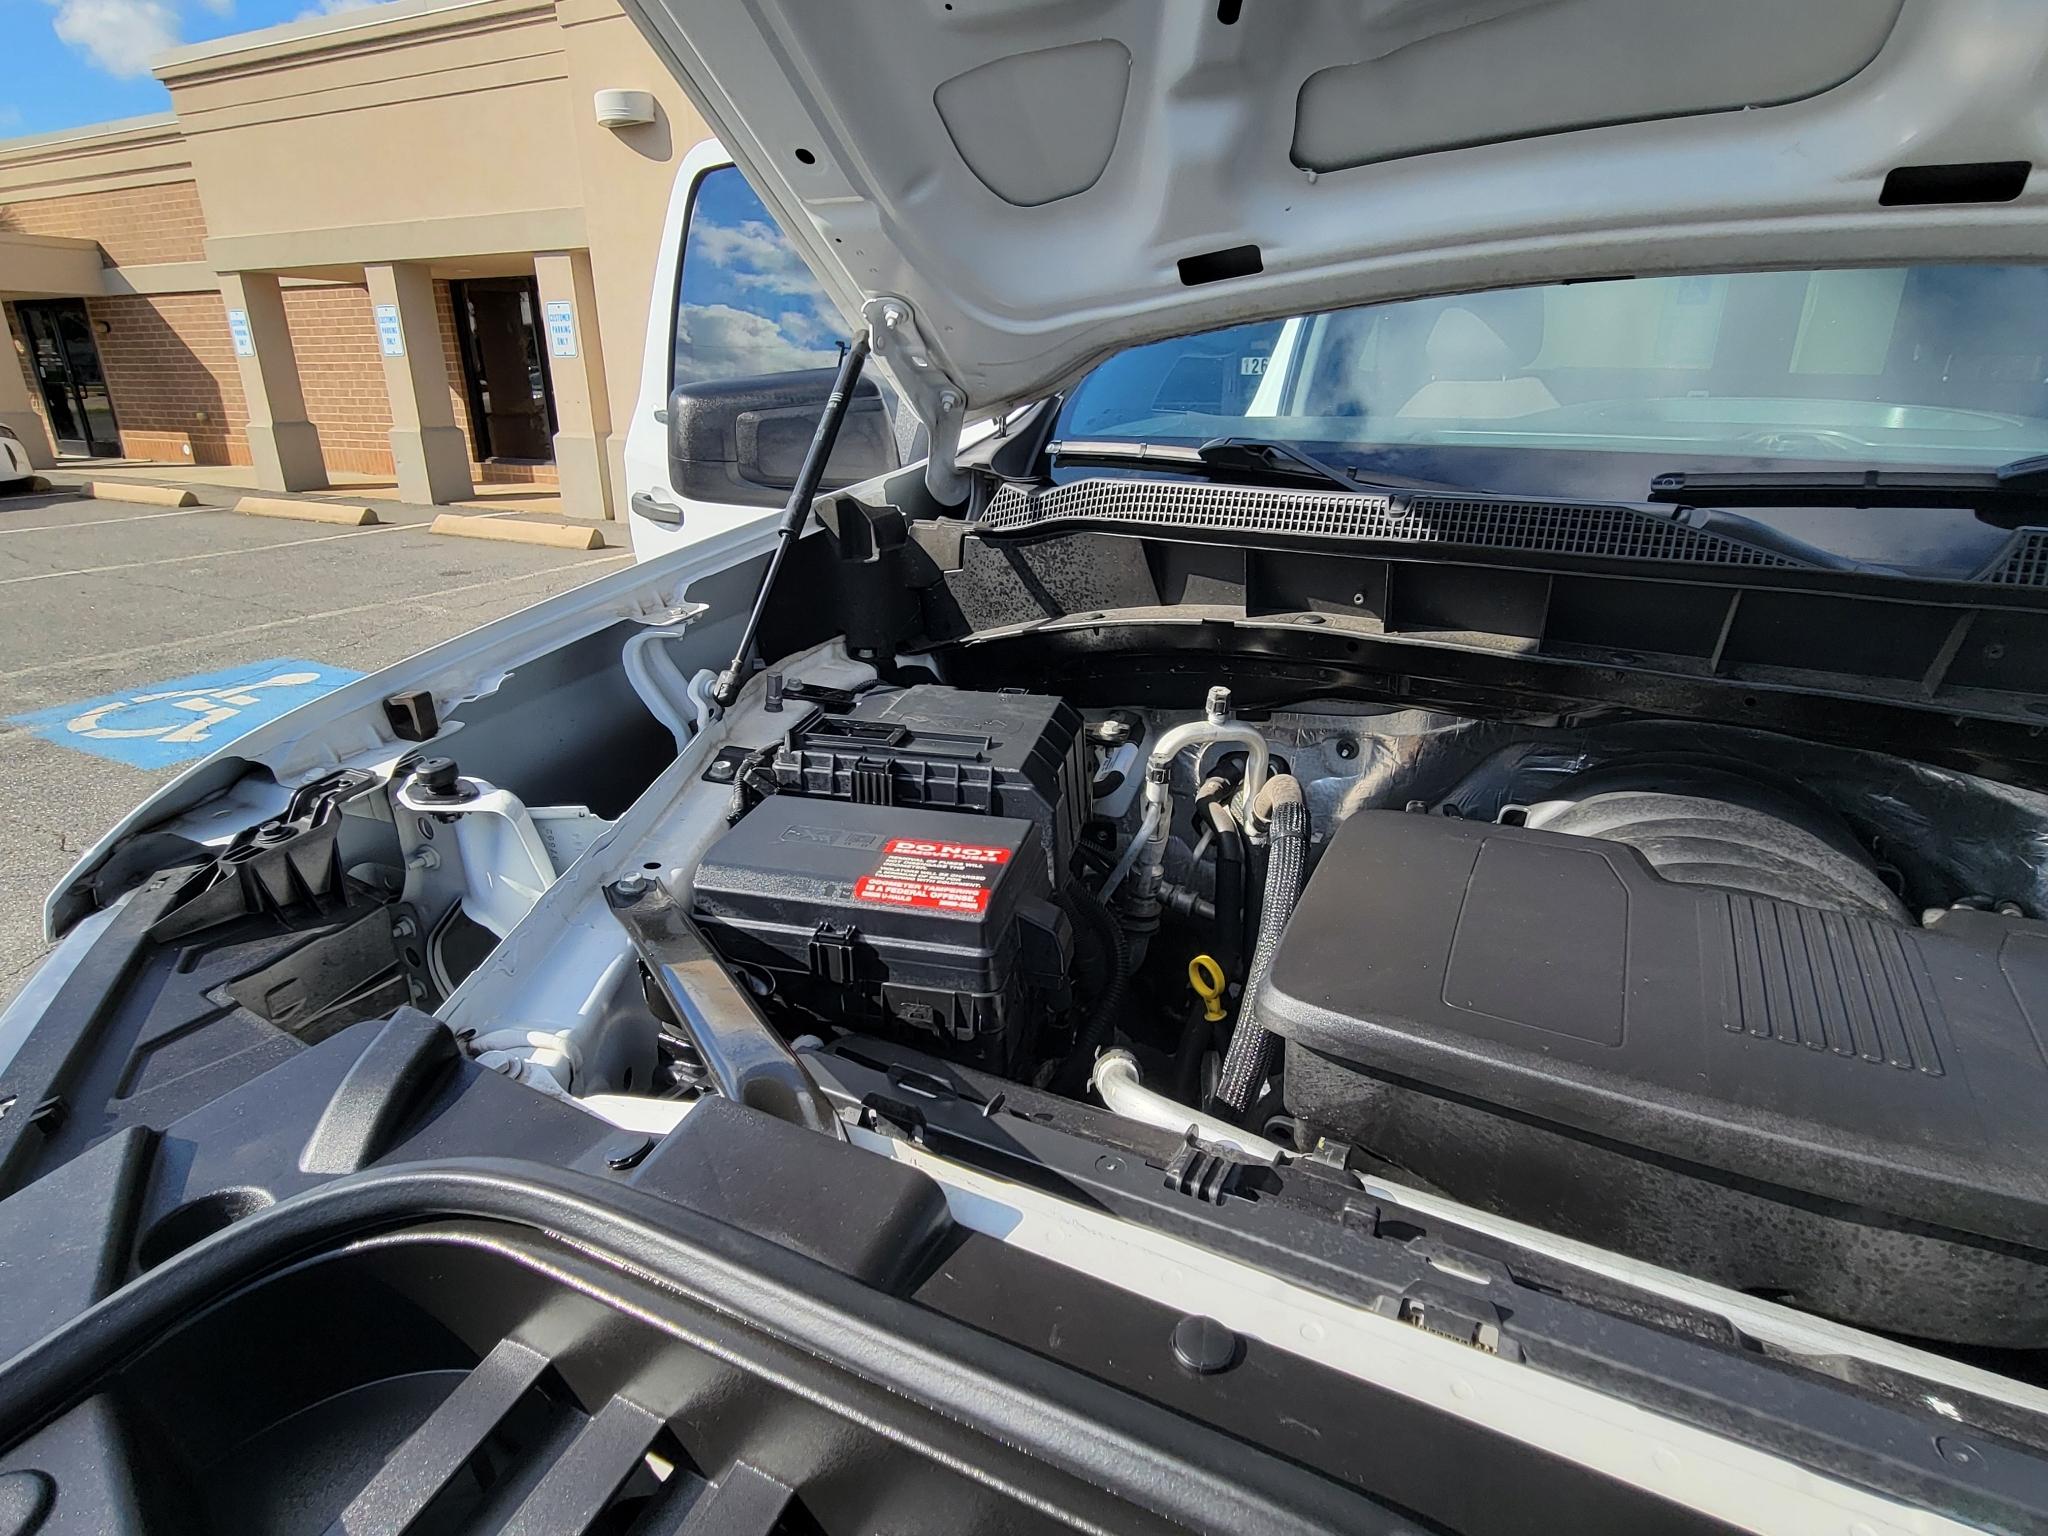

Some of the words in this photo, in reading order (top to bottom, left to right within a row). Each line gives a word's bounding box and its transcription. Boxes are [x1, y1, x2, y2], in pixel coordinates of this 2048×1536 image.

[552, 325, 571, 334] PARKING
[892, 848, 950, 857] REMOVE
[952, 854, 997, 862] FUSES
[895, 842, 936, 852] DO
[941, 846, 1002, 857] NOT
[868, 879, 922, 890] ODOMETER
[923, 884, 979, 896] TAMPERING
[884, 886, 928, 898] FEDERAL
[929, 892, 977, 903] OFFENSE.
